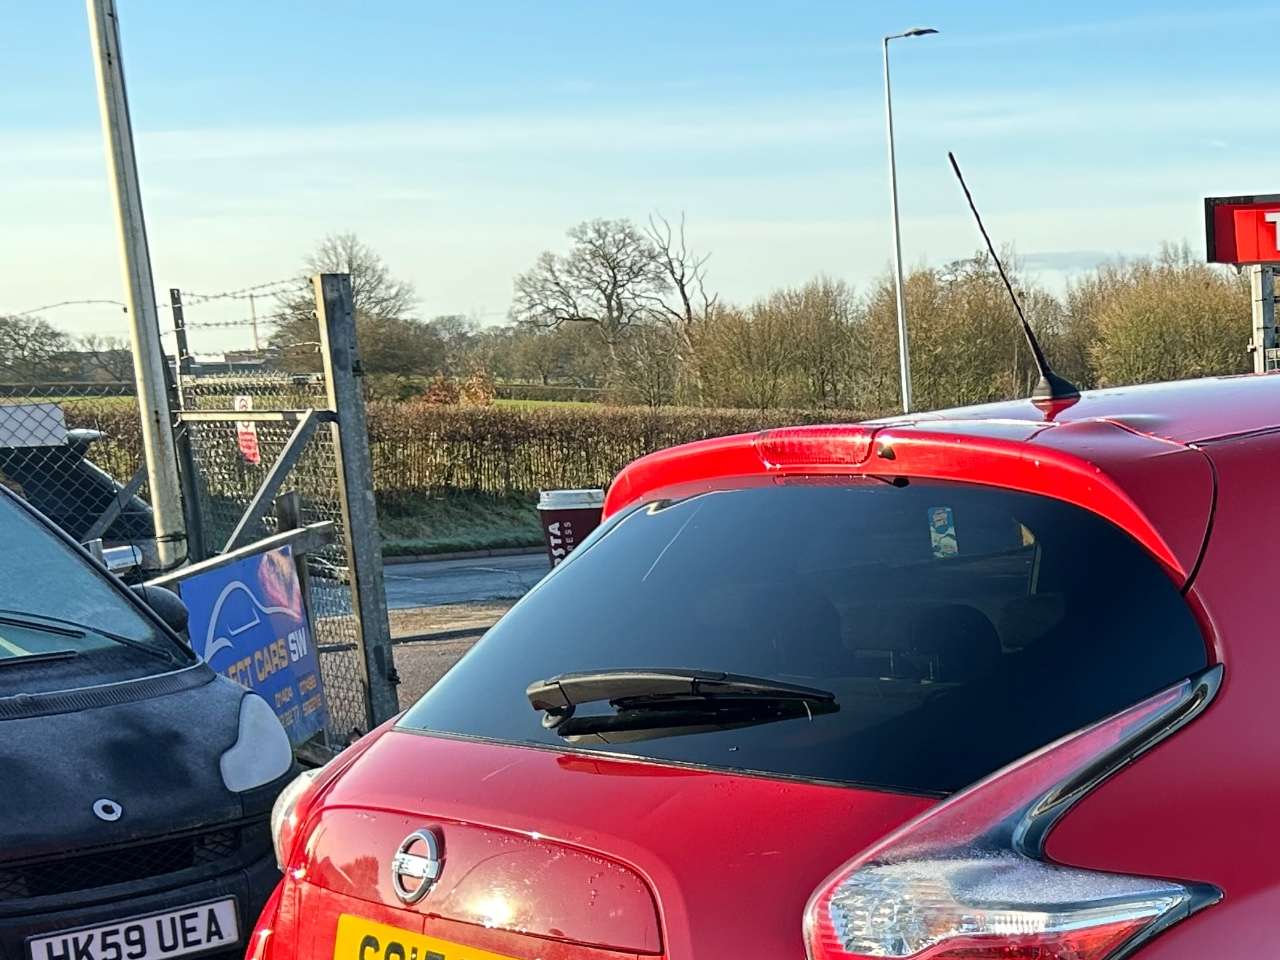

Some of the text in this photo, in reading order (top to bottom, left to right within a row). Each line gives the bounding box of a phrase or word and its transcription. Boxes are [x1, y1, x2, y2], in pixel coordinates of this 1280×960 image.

[254, 638, 289, 682] CARS
[287, 627, 308, 662] SW
[155, 908, 224, 953] UEA
